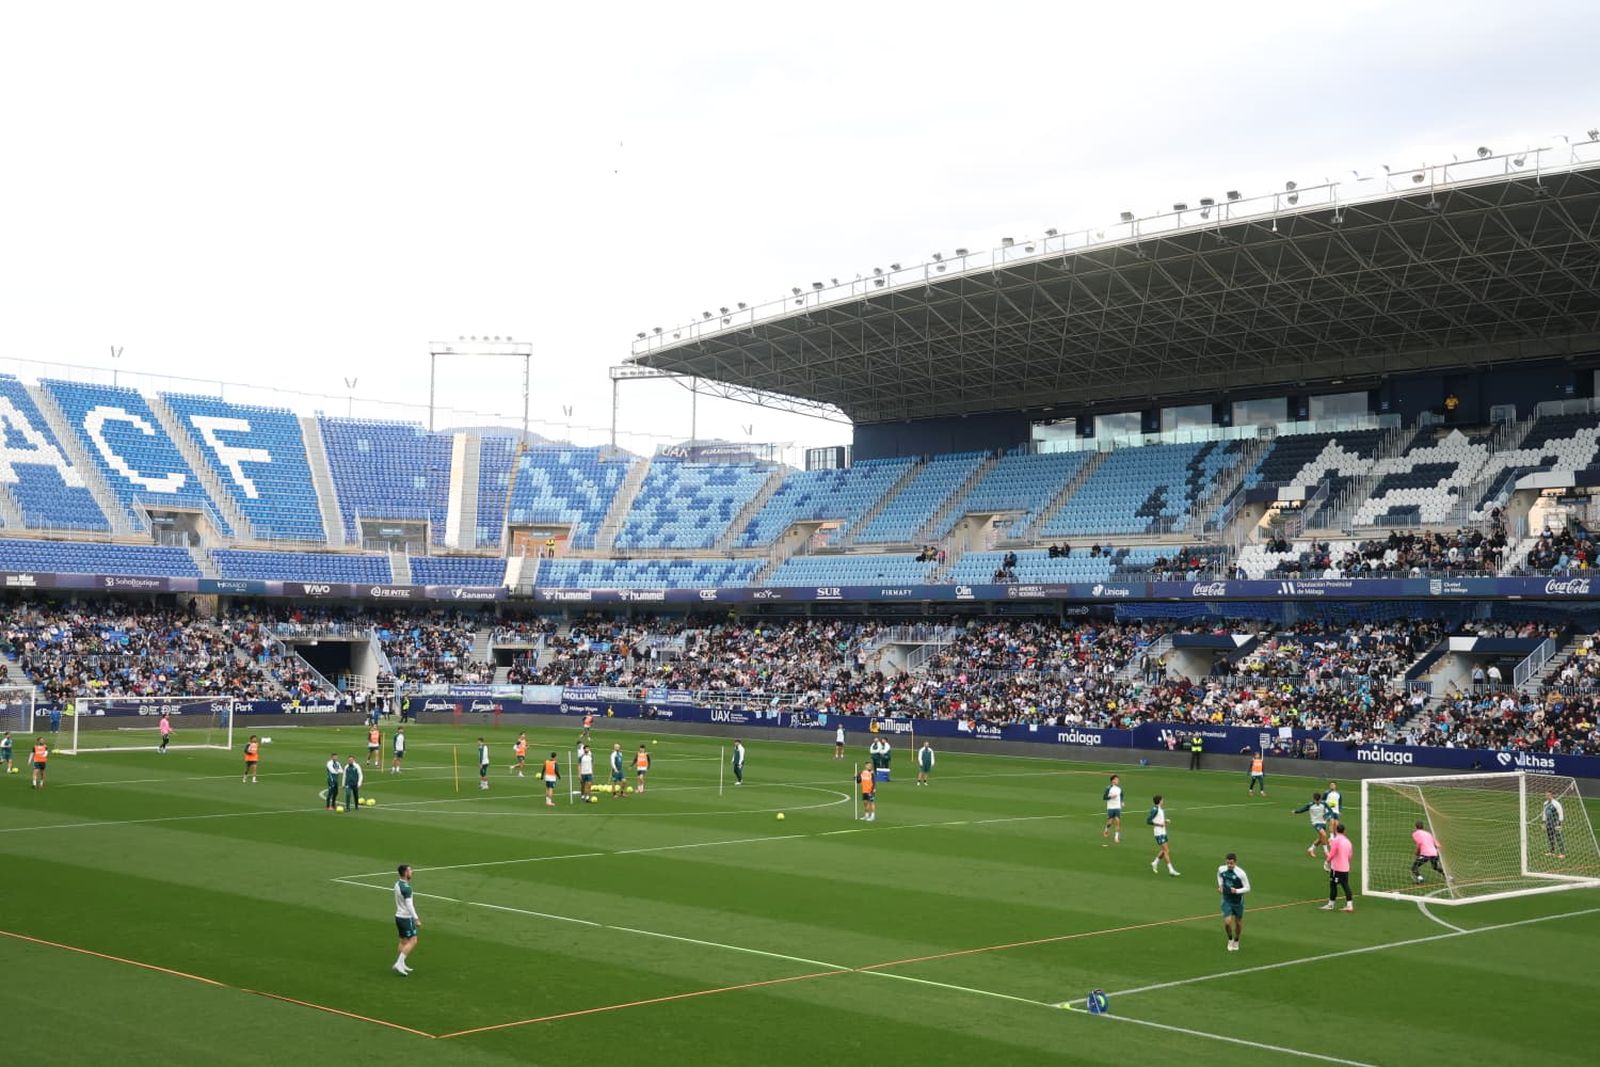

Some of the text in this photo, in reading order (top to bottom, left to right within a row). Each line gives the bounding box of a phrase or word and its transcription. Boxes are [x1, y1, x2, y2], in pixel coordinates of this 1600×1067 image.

[462, 591, 495, 599] Sanamar
[554, 589, 591, 600] hummel
[630, 589, 664, 600] hummel
[817, 587, 841, 596] SUR
[711, 710, 730, 722] UAX
